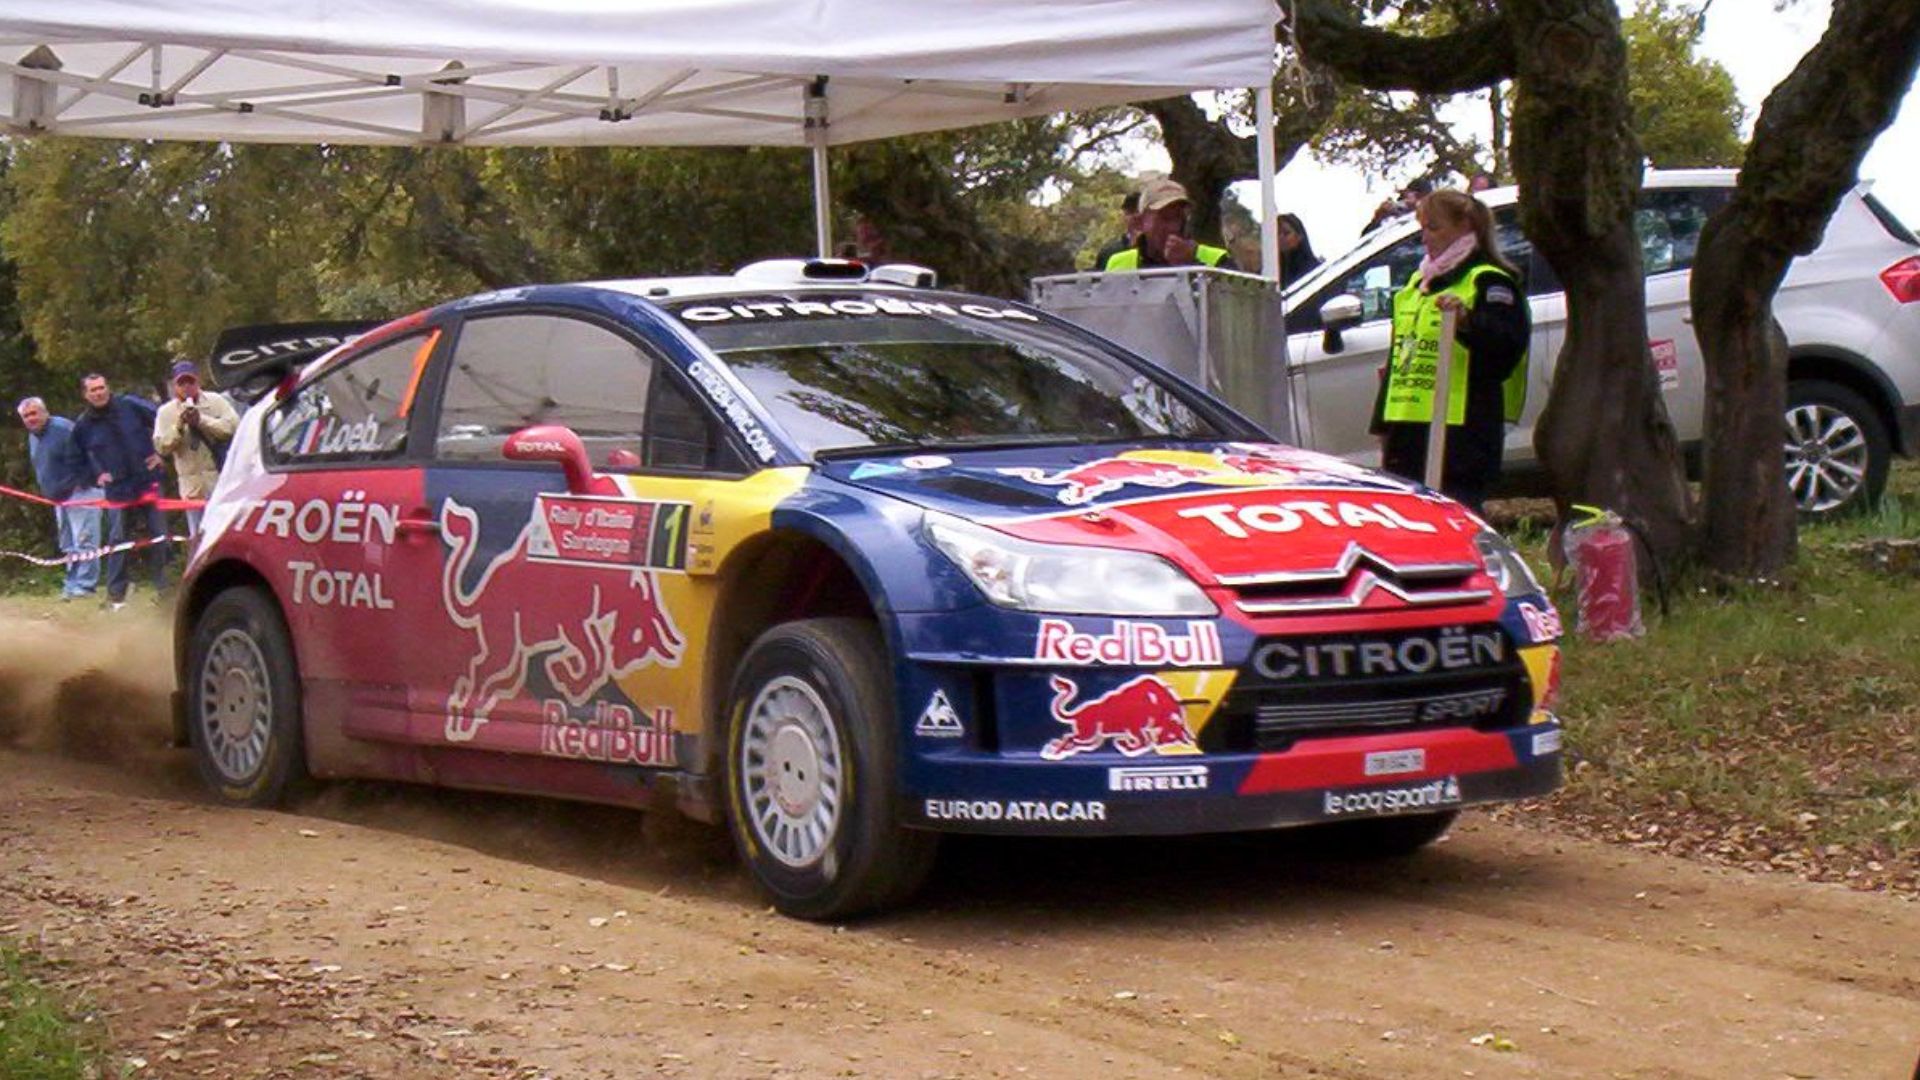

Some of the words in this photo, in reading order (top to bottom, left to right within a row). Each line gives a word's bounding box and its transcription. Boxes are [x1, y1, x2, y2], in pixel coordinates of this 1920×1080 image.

[514, 441, 566, 452] TOTAL
[664, 504, 684, 568] 1
[1176, 500, 1437, 539] TOTAL
[287, 560, 395, 610] TOTAL
[1252, 626, 1504, 680] CITROËN
[1108, 765, 1208, 791] PIRELLI
